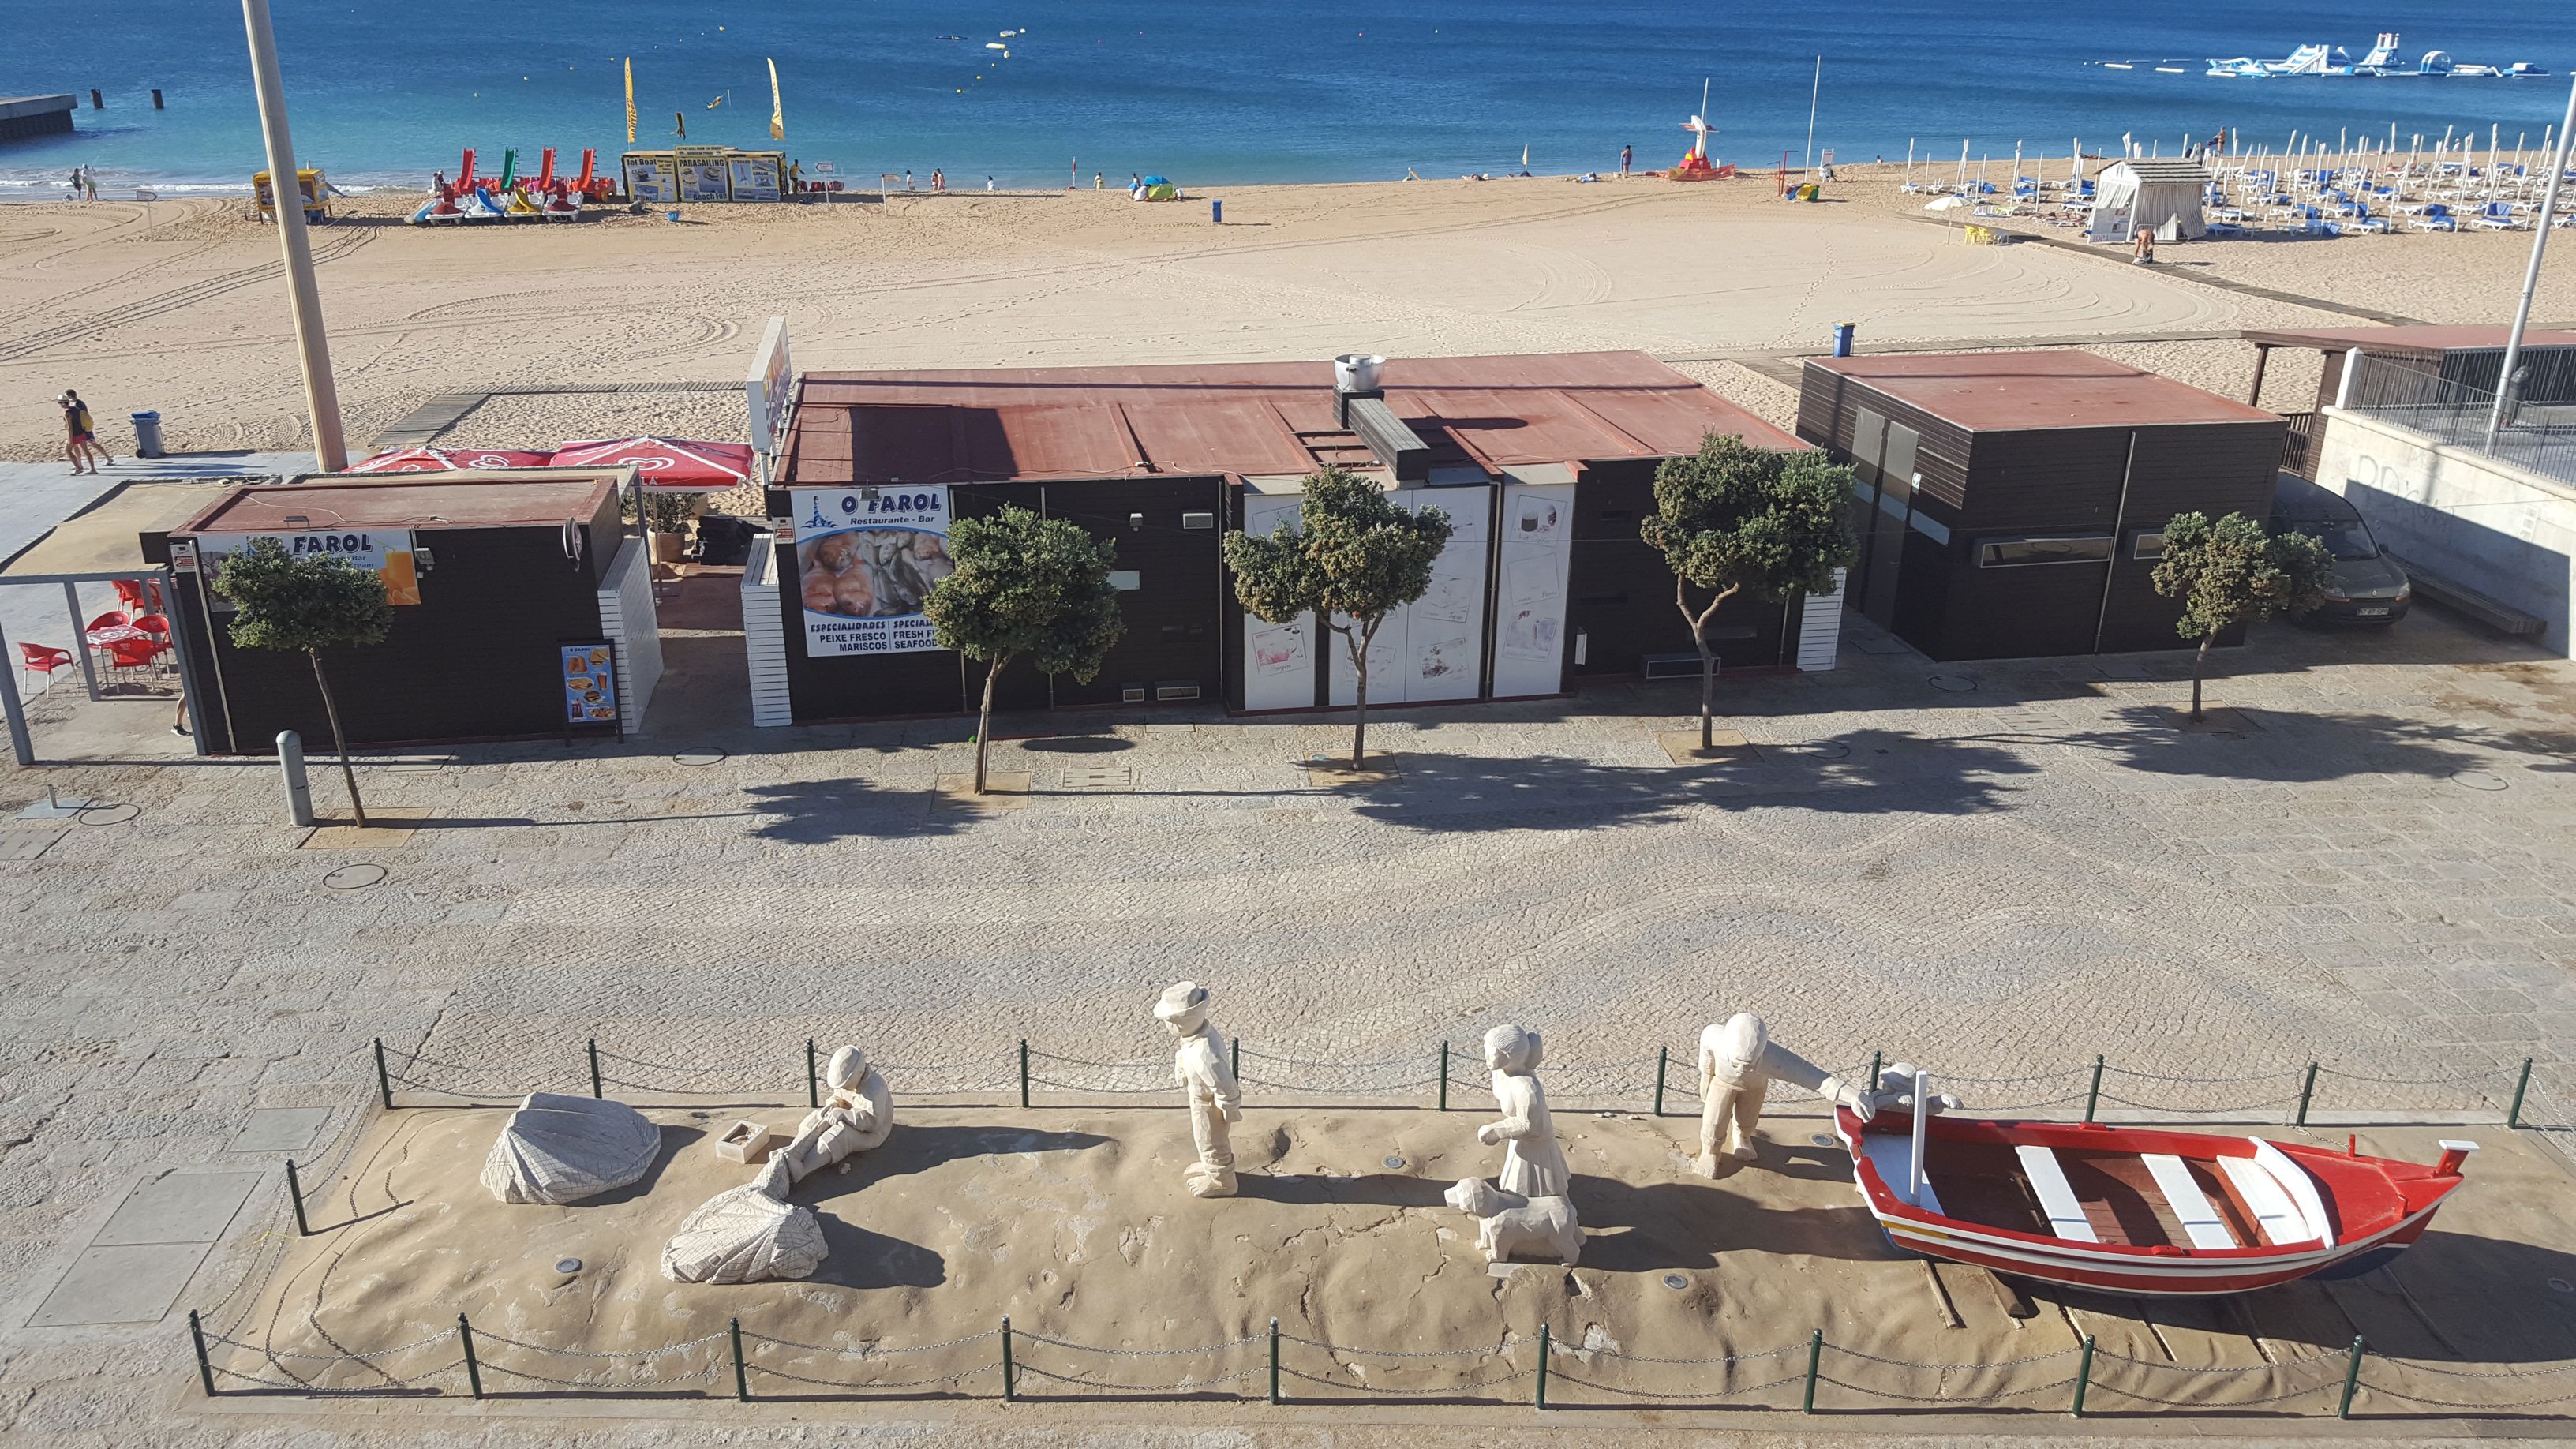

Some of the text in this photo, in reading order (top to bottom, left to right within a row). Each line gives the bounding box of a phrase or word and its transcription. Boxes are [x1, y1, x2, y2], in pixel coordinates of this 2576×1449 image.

[841, 493, 942, 515] O FAROL
[850, 516, 909, 525] Restaurante
[293, 534, 374, 556] FAROL
[810, 621, 886, 632] ESPECIALIDADES
[819, 632, 886, 643] PEIXE FRESCO
[893, 630, 924, 639] FRESH
[839, 642, 887, 652] MARISCOS
[894, 639, 938, 649] SEAFOOD
